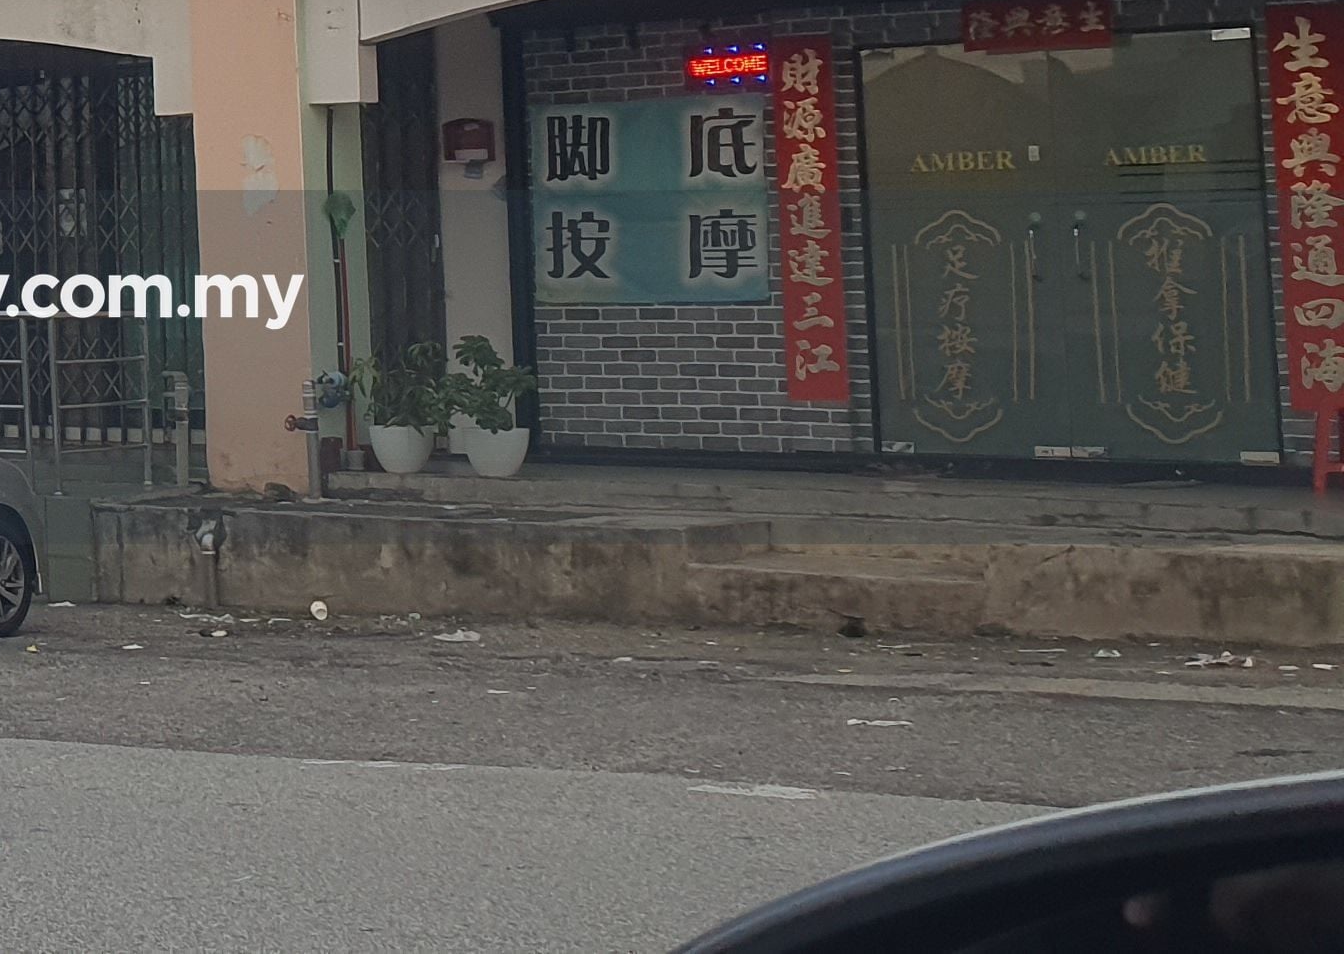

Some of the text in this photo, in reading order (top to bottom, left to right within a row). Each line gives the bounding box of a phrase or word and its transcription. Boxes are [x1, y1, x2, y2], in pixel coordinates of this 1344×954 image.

[689, 54, 767, 76] WELCOME
[910, 148, 1017, 174] AMBER
[1103, 143, 1208, 167] AMBER
